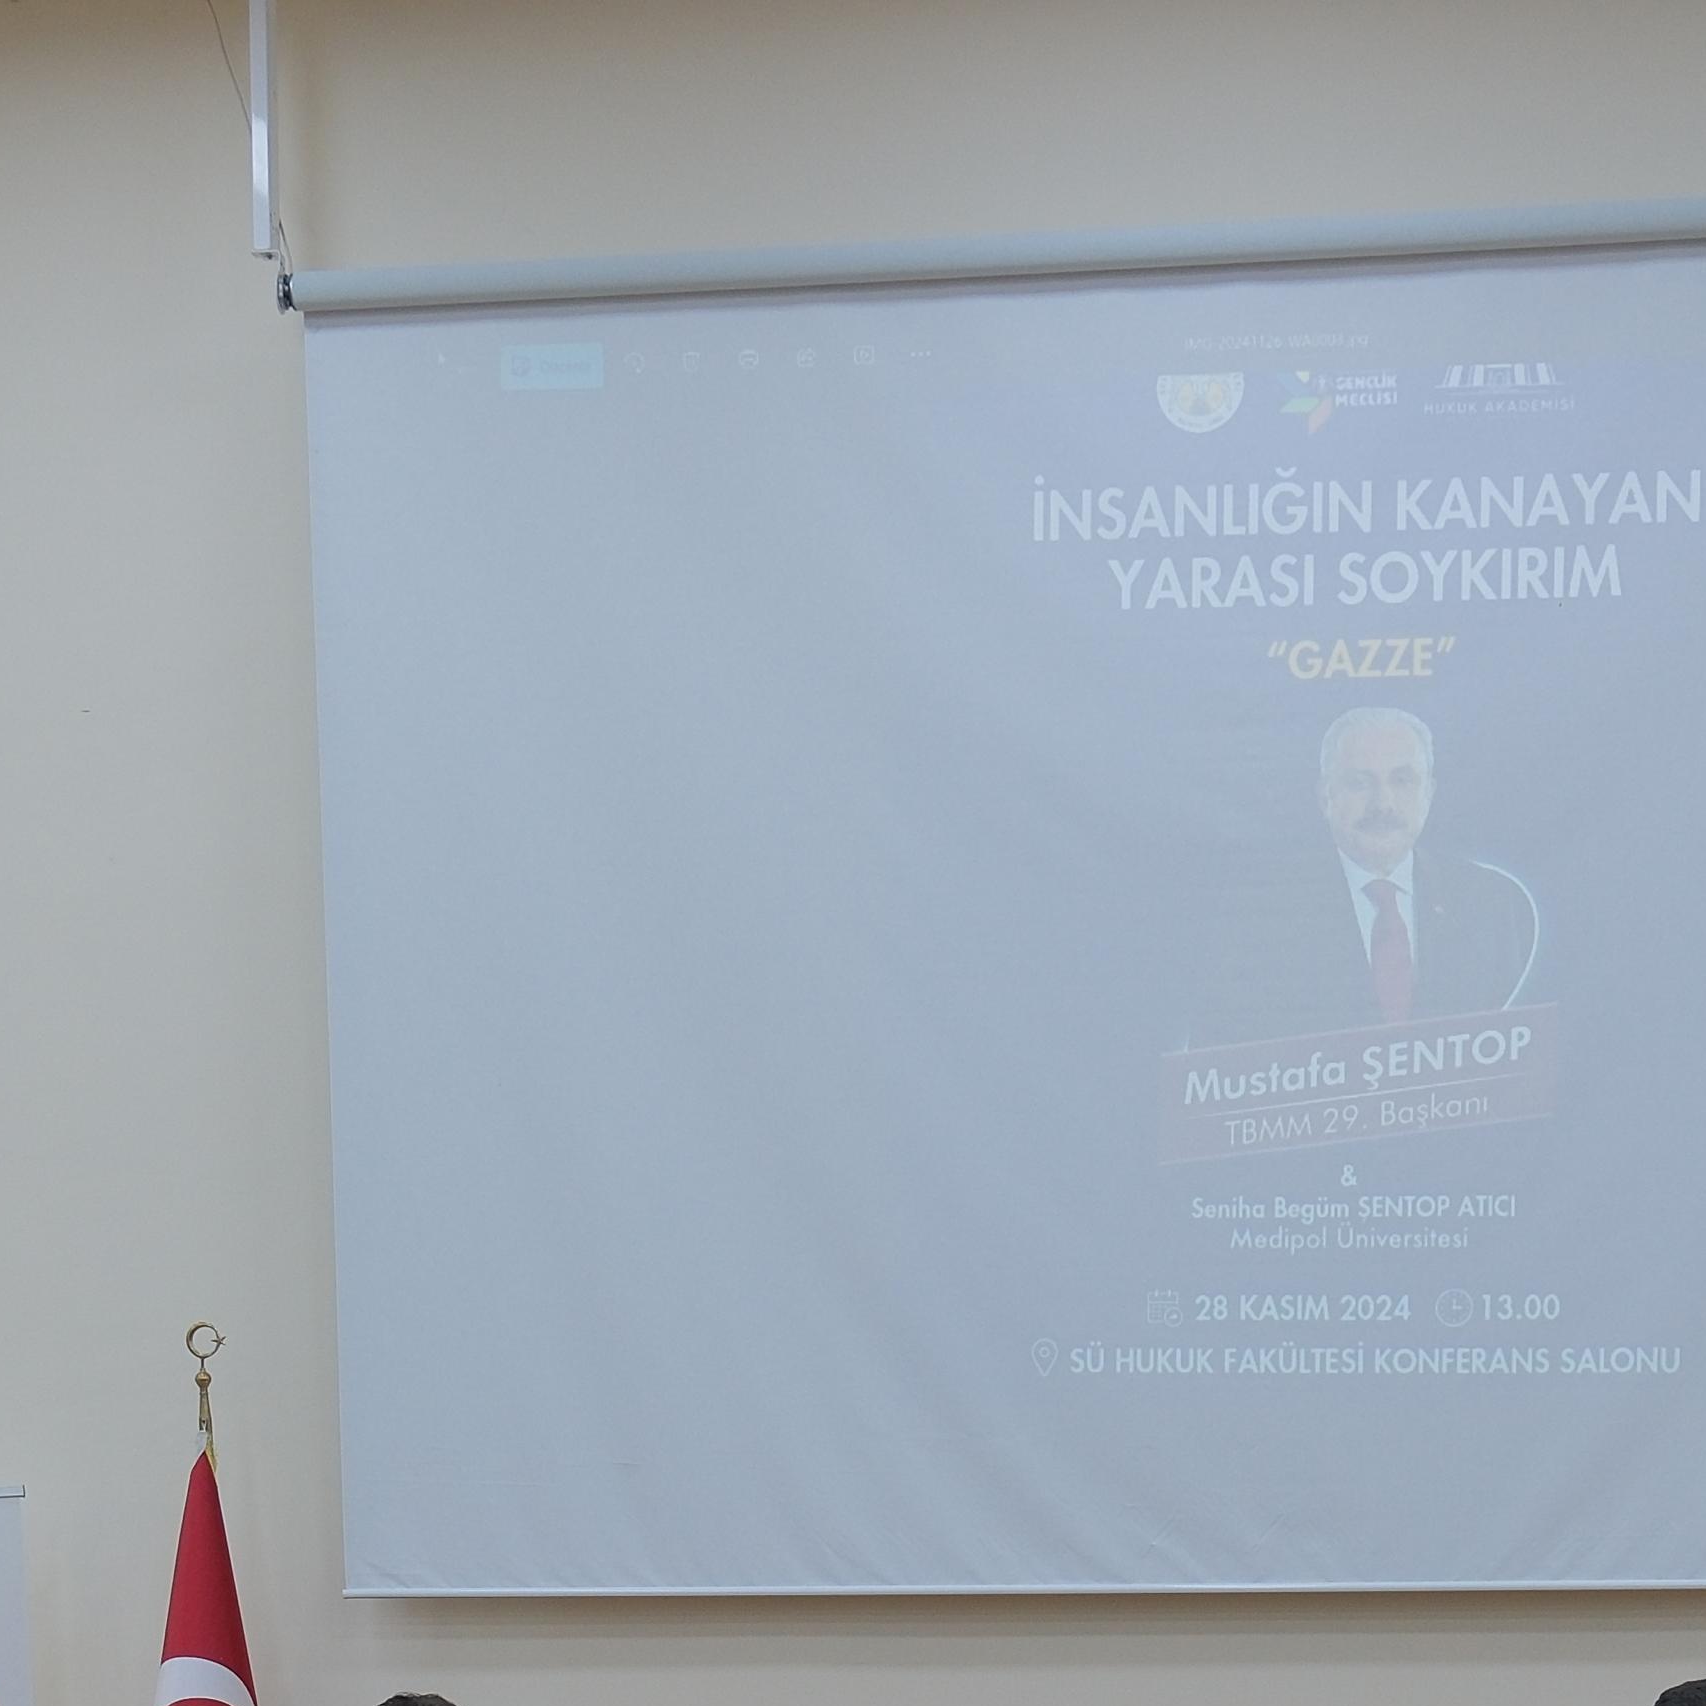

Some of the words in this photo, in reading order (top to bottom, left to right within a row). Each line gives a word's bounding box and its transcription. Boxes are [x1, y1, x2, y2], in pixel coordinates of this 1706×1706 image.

[1033, 466, 1372, 542] İNSANLIĞIN
[1397, 469, 1702, 531] KANAYAN
[1107, 554, 1315, 609] YARASI
[1338, 544, 1622, 604] SOYKIRIM
[1183, 1051, 1347, 1105] Mustafa
[1362, 1025, 1532, 1091] ŞENTOP
[1224, 1121, 1313, 1147] TBMM
[1322, 1105, 1369, 1133] 29.
[1380, 1094, 1490, 1130] Başkanı
[1339, 1165, 1357, 1187] &
[1191, 1197, 1267, 1219] Seniha
[1274, 1197, 1350, 1224] Begüm
[1457, 1195, 1516, 1217] ATICI
[1230, 1226, 1328, 1255] Medipol
[1336, 1221, 1469, 1249] Üniversitesi
[1195, 1295, 1229, 1321] 28
[1239, 1295, 1329, 1321] KASIM
[1340, 1294, 1412, 1320] 2024
[1481, 1293, 1560, 1320] 13.00
[1070, 1345, 1105, 1373] SÜ
[1115, 1348, 1214, 1373] HUKUK
[1223, 1342, 1364, 1373] FAKÜLTESİ
[1373, 1346, 1549, 1373] KONFERANS
[1560, 1345, 1681, 1372] SALONU
